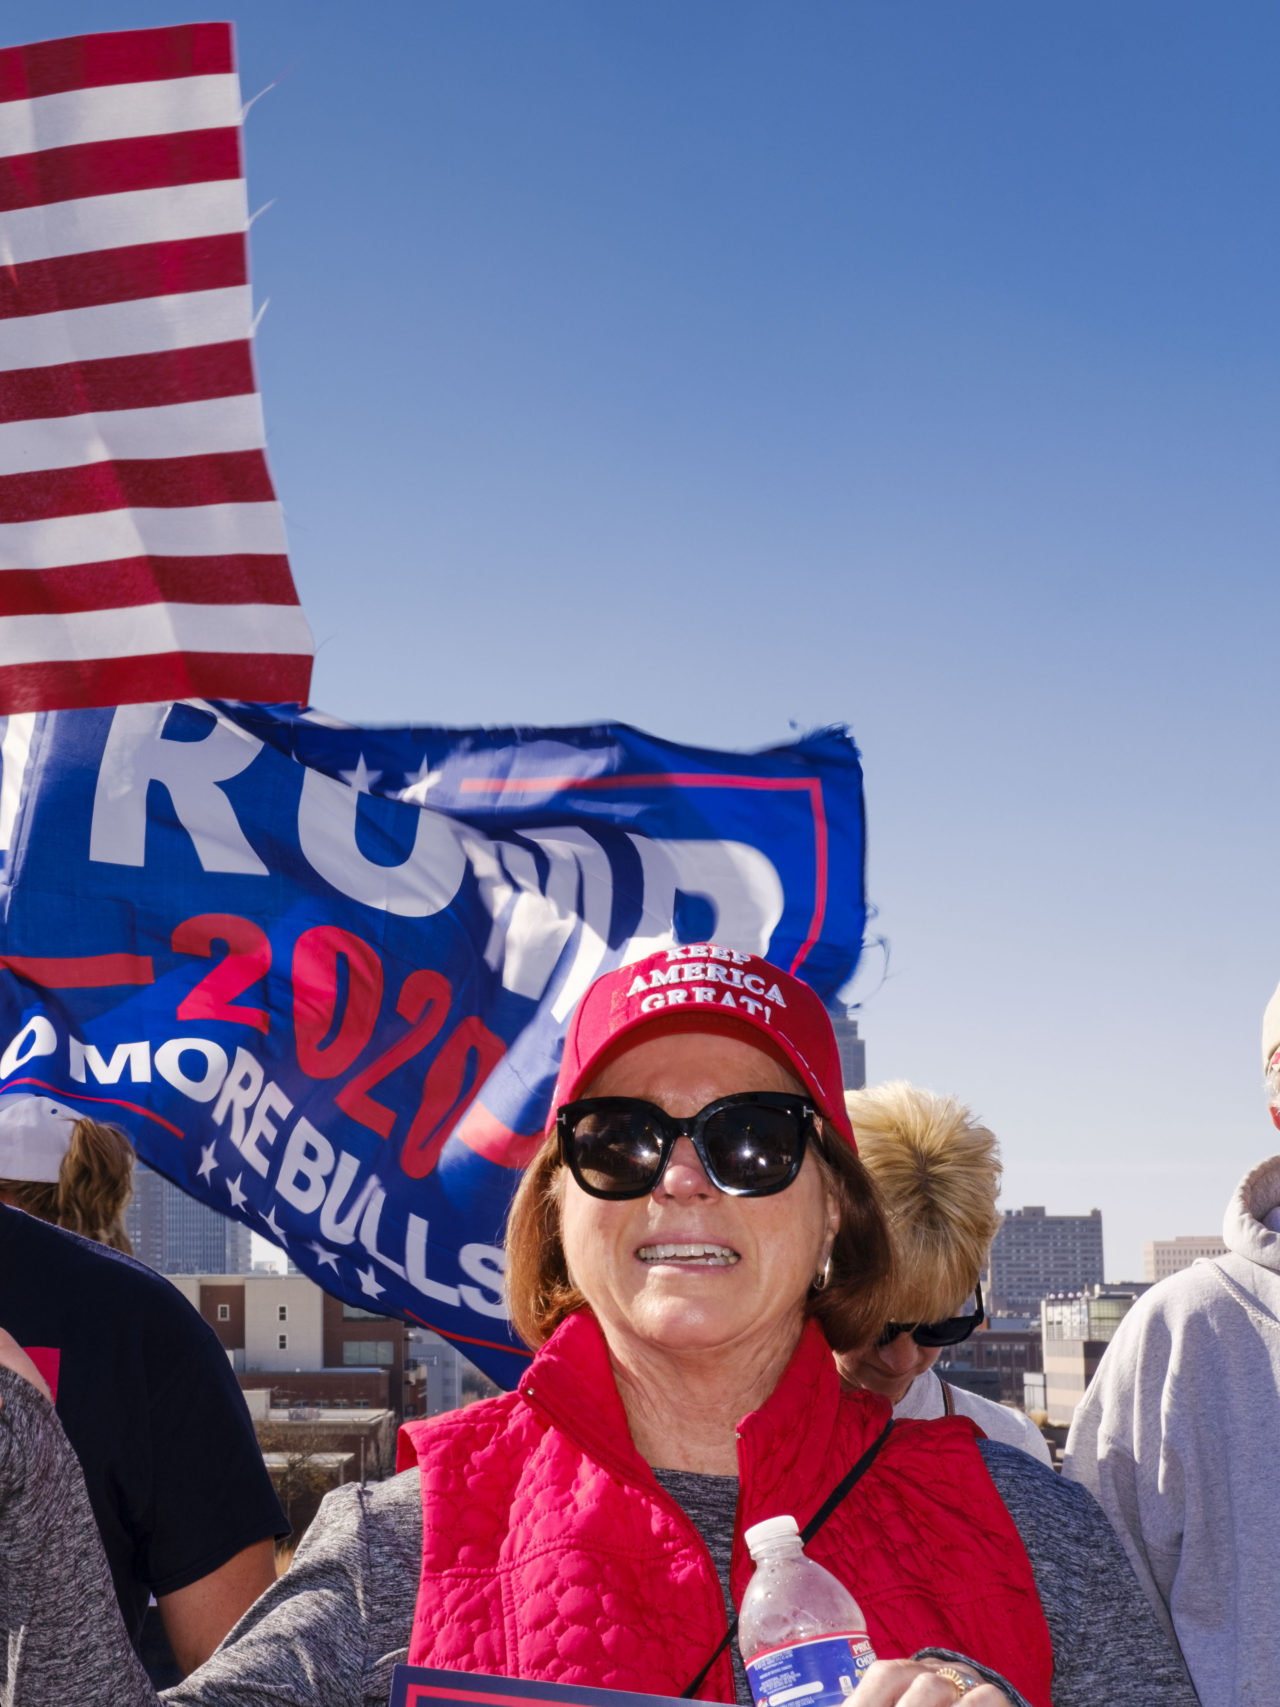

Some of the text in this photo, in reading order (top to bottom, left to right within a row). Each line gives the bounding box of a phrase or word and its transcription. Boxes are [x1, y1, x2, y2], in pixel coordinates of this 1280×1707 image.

[666, 945, 751, 965] KEEP
[626, 962, 787, 1008] AMERICA
[641, 986, 772, 1025] GREAT!
[170, 912, 508, 1179] 2020
[69, 1035, 294, 1179] MORE
[274, 1116, 512, 1321] BULLS
